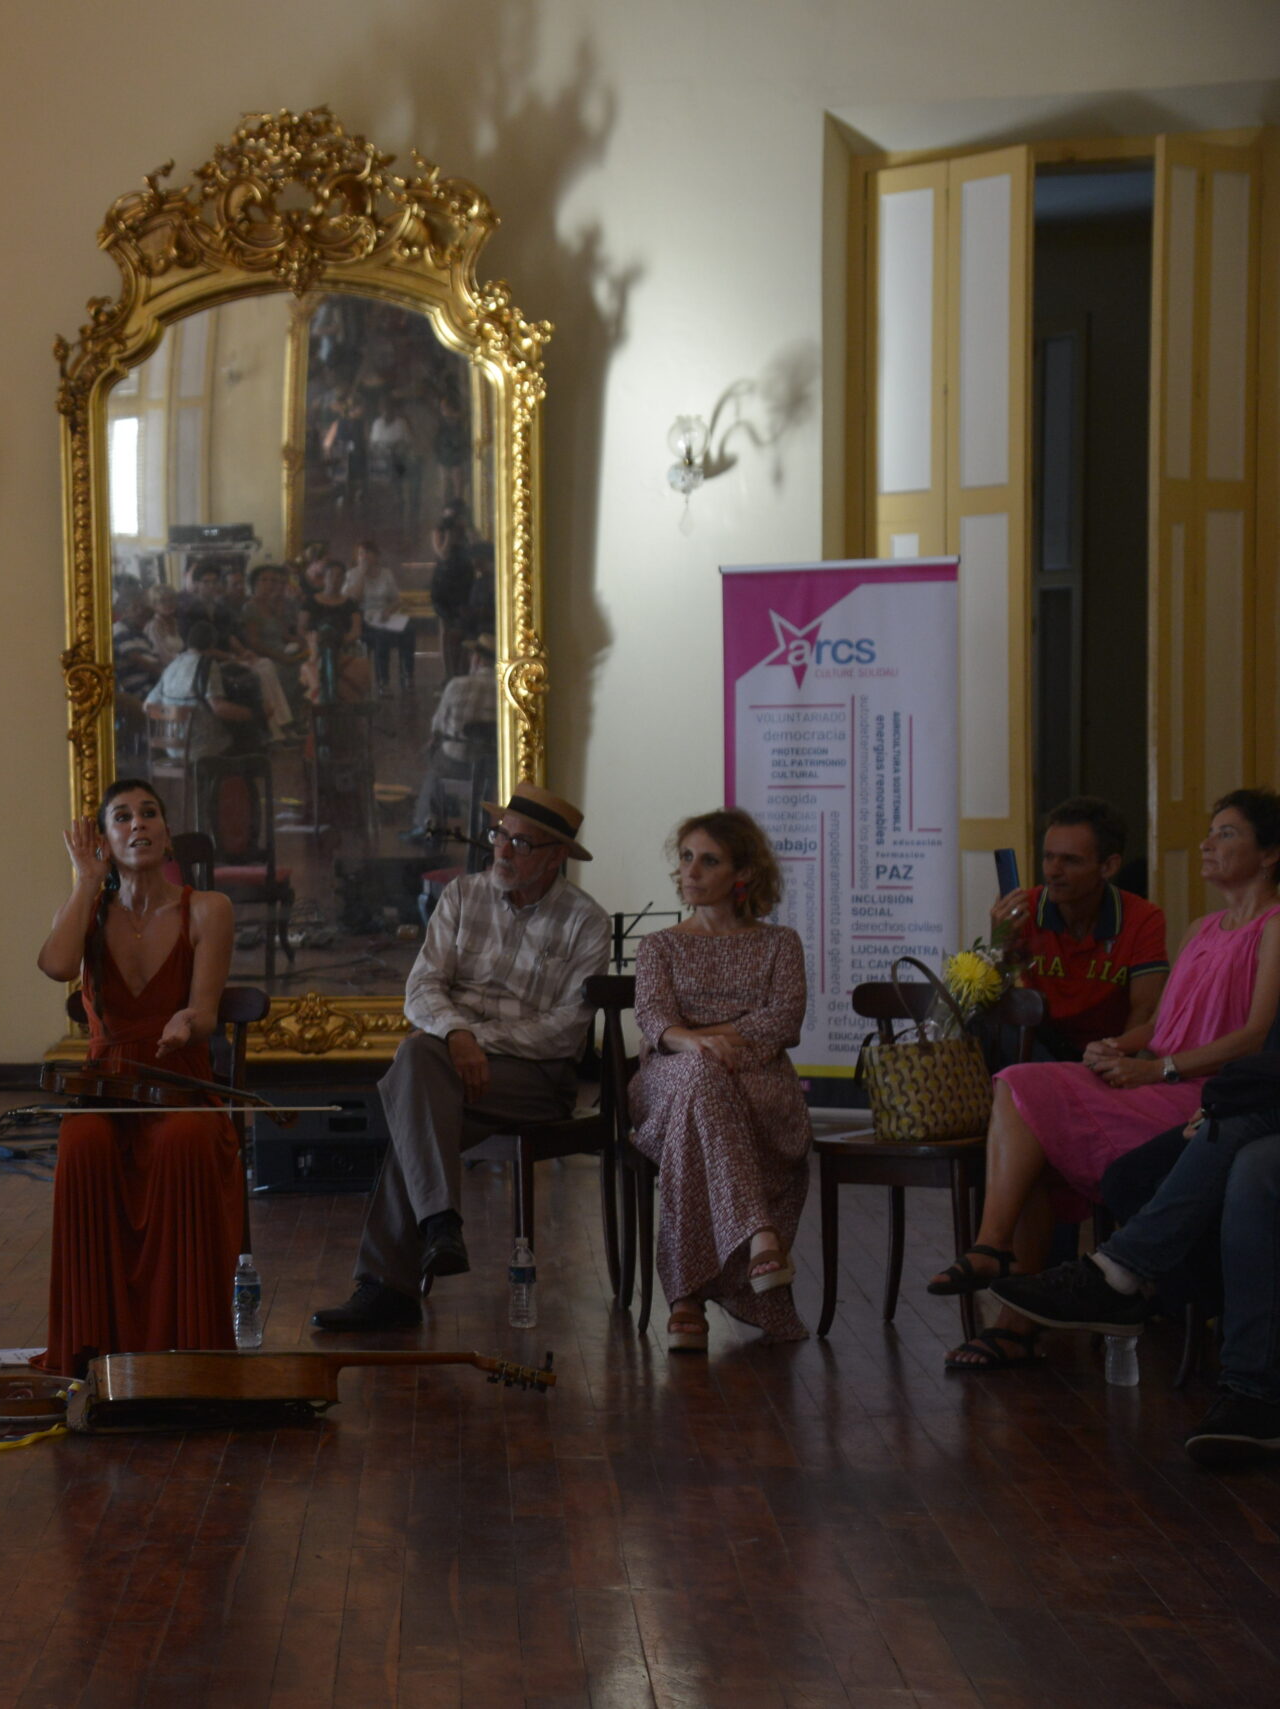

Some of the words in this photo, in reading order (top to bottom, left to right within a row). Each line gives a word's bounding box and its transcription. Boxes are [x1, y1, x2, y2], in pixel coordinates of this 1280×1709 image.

[787, 638, 877, 666] arcs
[756, 711, 846, 723] VOLUNTARIADO
[763, 728, 846, 742] democracia
[790, 758, 847, 768] PATRIMONIO
[771, 770, 818, 779] CULTURAL
[767, 793, 817, 807] acogida
[875, 773, 887, 845] renovables
[774, 837, 817, 855] abajo
[875, 863, 914, 880] PAZ
[851, 906, 893, 917] SOCIAL
[851, 920, 906, 932] derechos
[851, 944, 890, 956] LUCHA
[892, 944, 939, 956] CONTRA
[851, 958, 865, 969] EL
